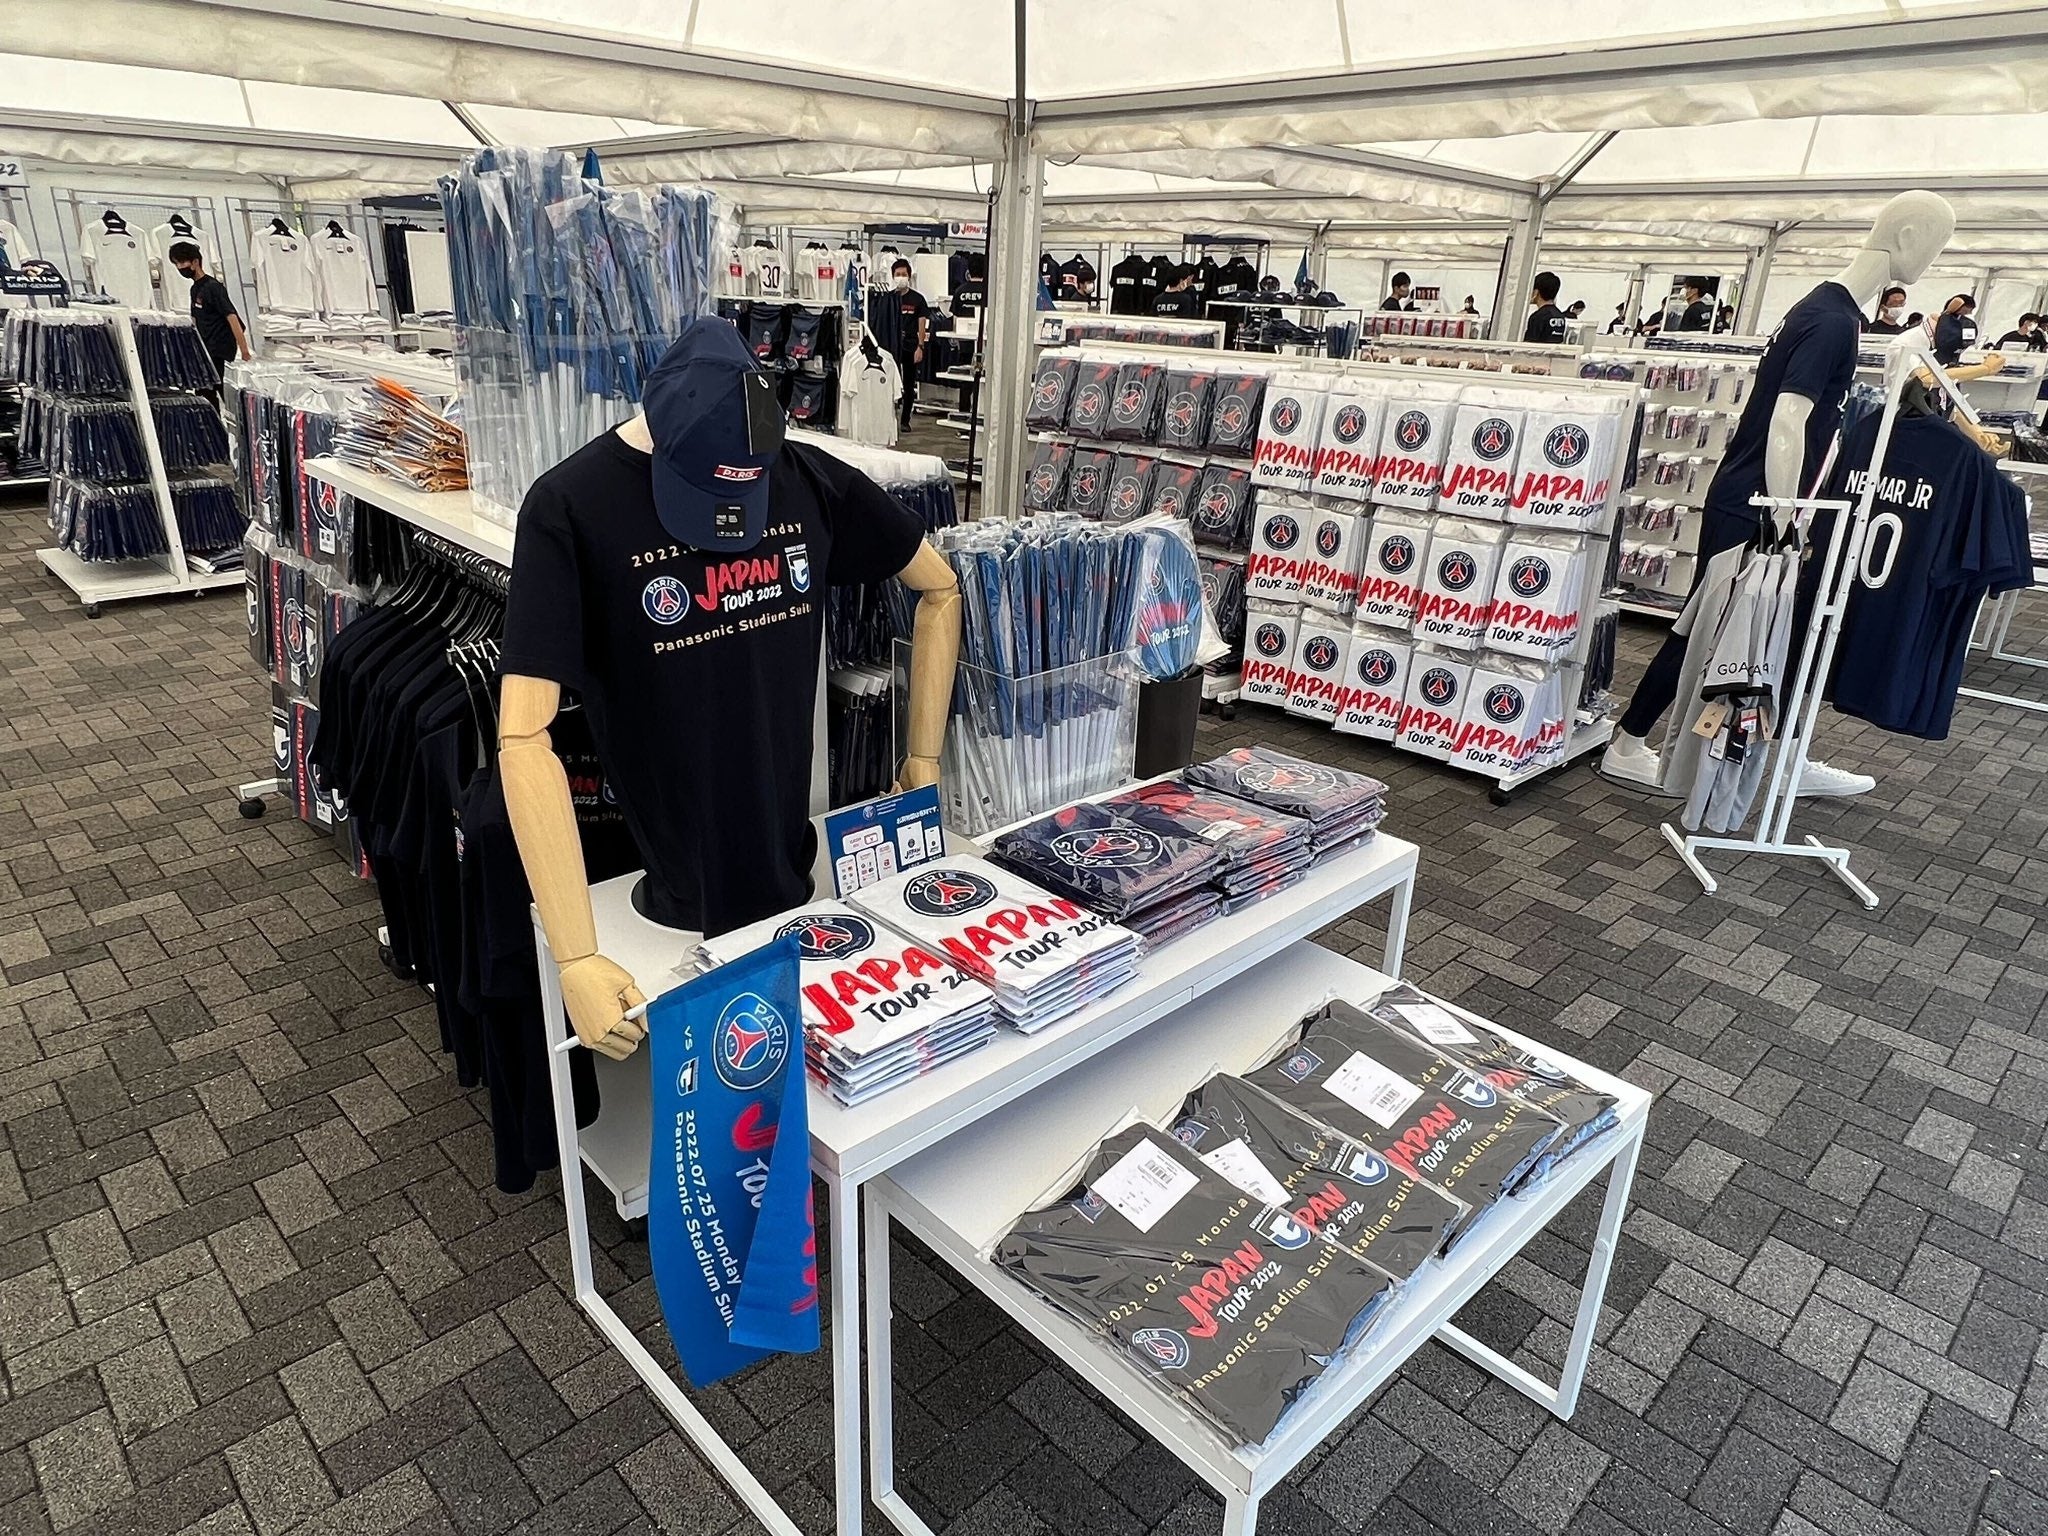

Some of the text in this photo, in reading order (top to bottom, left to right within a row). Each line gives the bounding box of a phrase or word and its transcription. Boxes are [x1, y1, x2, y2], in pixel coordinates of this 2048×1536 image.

[762, 265, 780, 288] 30
[1157, 304, 1179, 312] CREW
[1482, 421, 1507, 434] PARIS
[1554, 426, 1583, 438] PARIS
[722, 469, 755, 479] PARIS
[1259, 464, 1283, 476] TOUR
[1320, 473, 1346, 486] TOUR
[1441, 464, 1515, 498] JAPA
[1844, 469, 1906, 504] NEMAR
[1380, 482, 1408, 495] TOUR
[1457, 492, 1507, 508] TOUR 20
[1529, 500, 1565, 515] TOUR
[763, 522, 802, 539] onday
[1271, 516, 1293, 528] PARIS
[1447, 553, 1471, 566] PARIS
[1519, 557, 1544, 571] PARIS
[648, 579, 677, 595] PARIS
[695, 554, 779, 611] JAPAN
[1254, 577, 1282, 589] TOUR
[721, 584, 782, 613] TOUR 2022
[1305, 584, 1325, 599] TOUR
[1366, 601, 1393, 614] TOUR
[653, 602, 812, 654] Panasonic Stadium Suit
[1261, 625, 1280, 635] PARIS
[1424, 619, 1454, 634] TOUR
[1492, 627, 1524, 642] TOUR
[1150, 629, 1170, 646] TOUR
[1312, 637, 1334, 649] PARIS
[1367, 650, 1391, 663] PARIS
[1428, 670, 1452, 683] PARIS
[1248, 682, 1287, 696] TOUR 20
[1493, 685, 1518, 699] PARIS
[1291, 695, 1319, 708] TOUR
[1345, 712, 1375, 725] TOUR
[1406, 730, 1452, 751] TOUR 20
[1465, 748, 1498, 764] TOUR
[573, 796, 599, 806] 2022
[911, 872, 957, 895] PARIS
[938, 898, 1084, 978] JAPAN
[999, 931, 1067, 970] TOUR
[802, 947, 943, 1035] JAPA
[861, 983, 938, 1023] TOUR
[754, 1003, 784, 1060] PARIS
[1384, 1102, 1457, 1181] JAPAN
[1418, 1117, 1474, 1173] TOUR 2022
[1452, 1131, 1499, 1178] Stadium
[1283, 1140, 1326, 1188] Monda
[735, 1157, 770, 1208] TOU
[675, 1112, 694, 1215] Panasonic
[686, 1219, 721, 1292] Stadium
[686, 1109, 742, 1285] 2022.07.25 Monday
[1293, 1181, 1347, 1229] PAN
[1196, 1198, 1249, 1248] Monda
[1321, 1200, 1365, 1244] UR 2022
[1350, 1179, 1415, 1254] tadium Suit
[1177, 1240, 1264, 1337] JAPAN
[1217, 1260, 1283, 1324] TOUR 2022
[1254, 1276, 1311, 1332] Stadium
[1307, 1244, 1338, 1278] Suit
